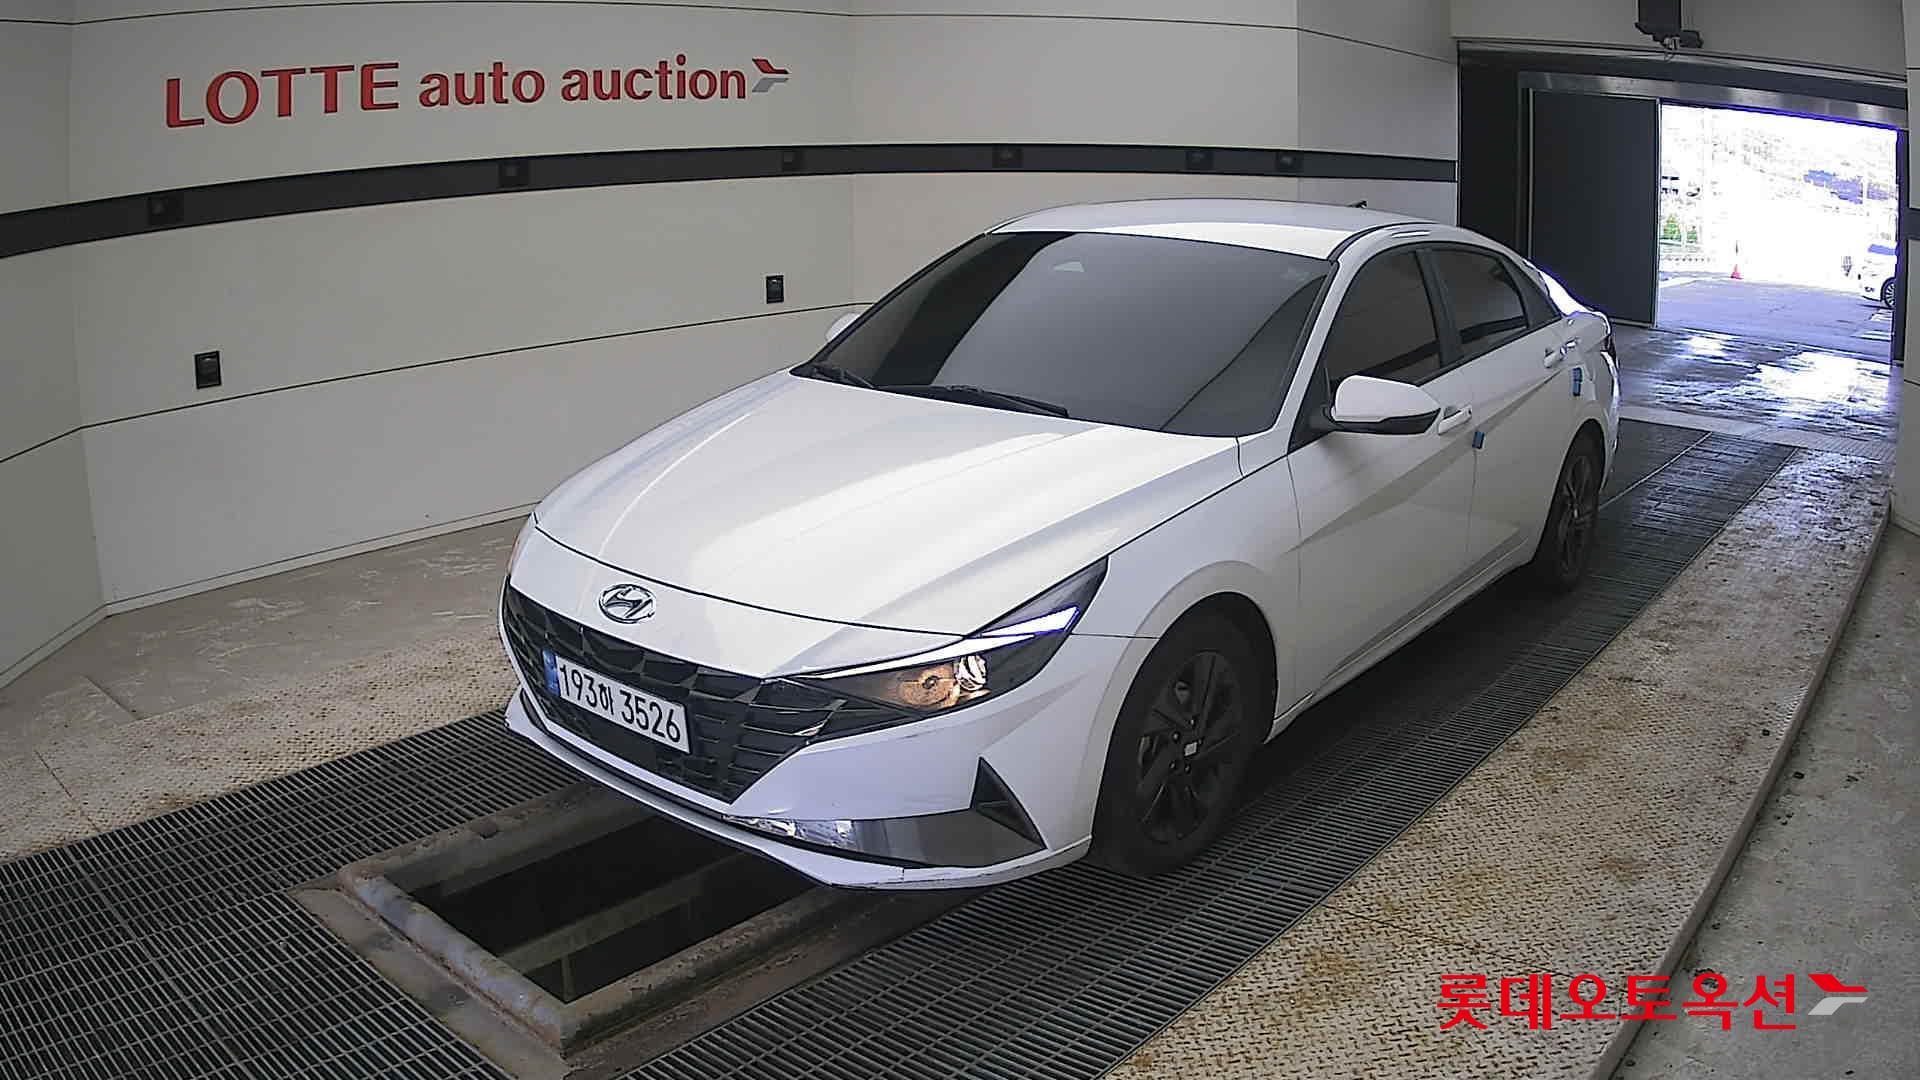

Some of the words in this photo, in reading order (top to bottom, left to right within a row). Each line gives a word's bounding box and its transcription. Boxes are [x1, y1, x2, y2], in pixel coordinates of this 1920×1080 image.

[165, 62, 400, 128] LOTTE
[418, 61, 546, 107] auto
[560, 54, 747, 101] auction
[619, 689, 682, 743] 3526
